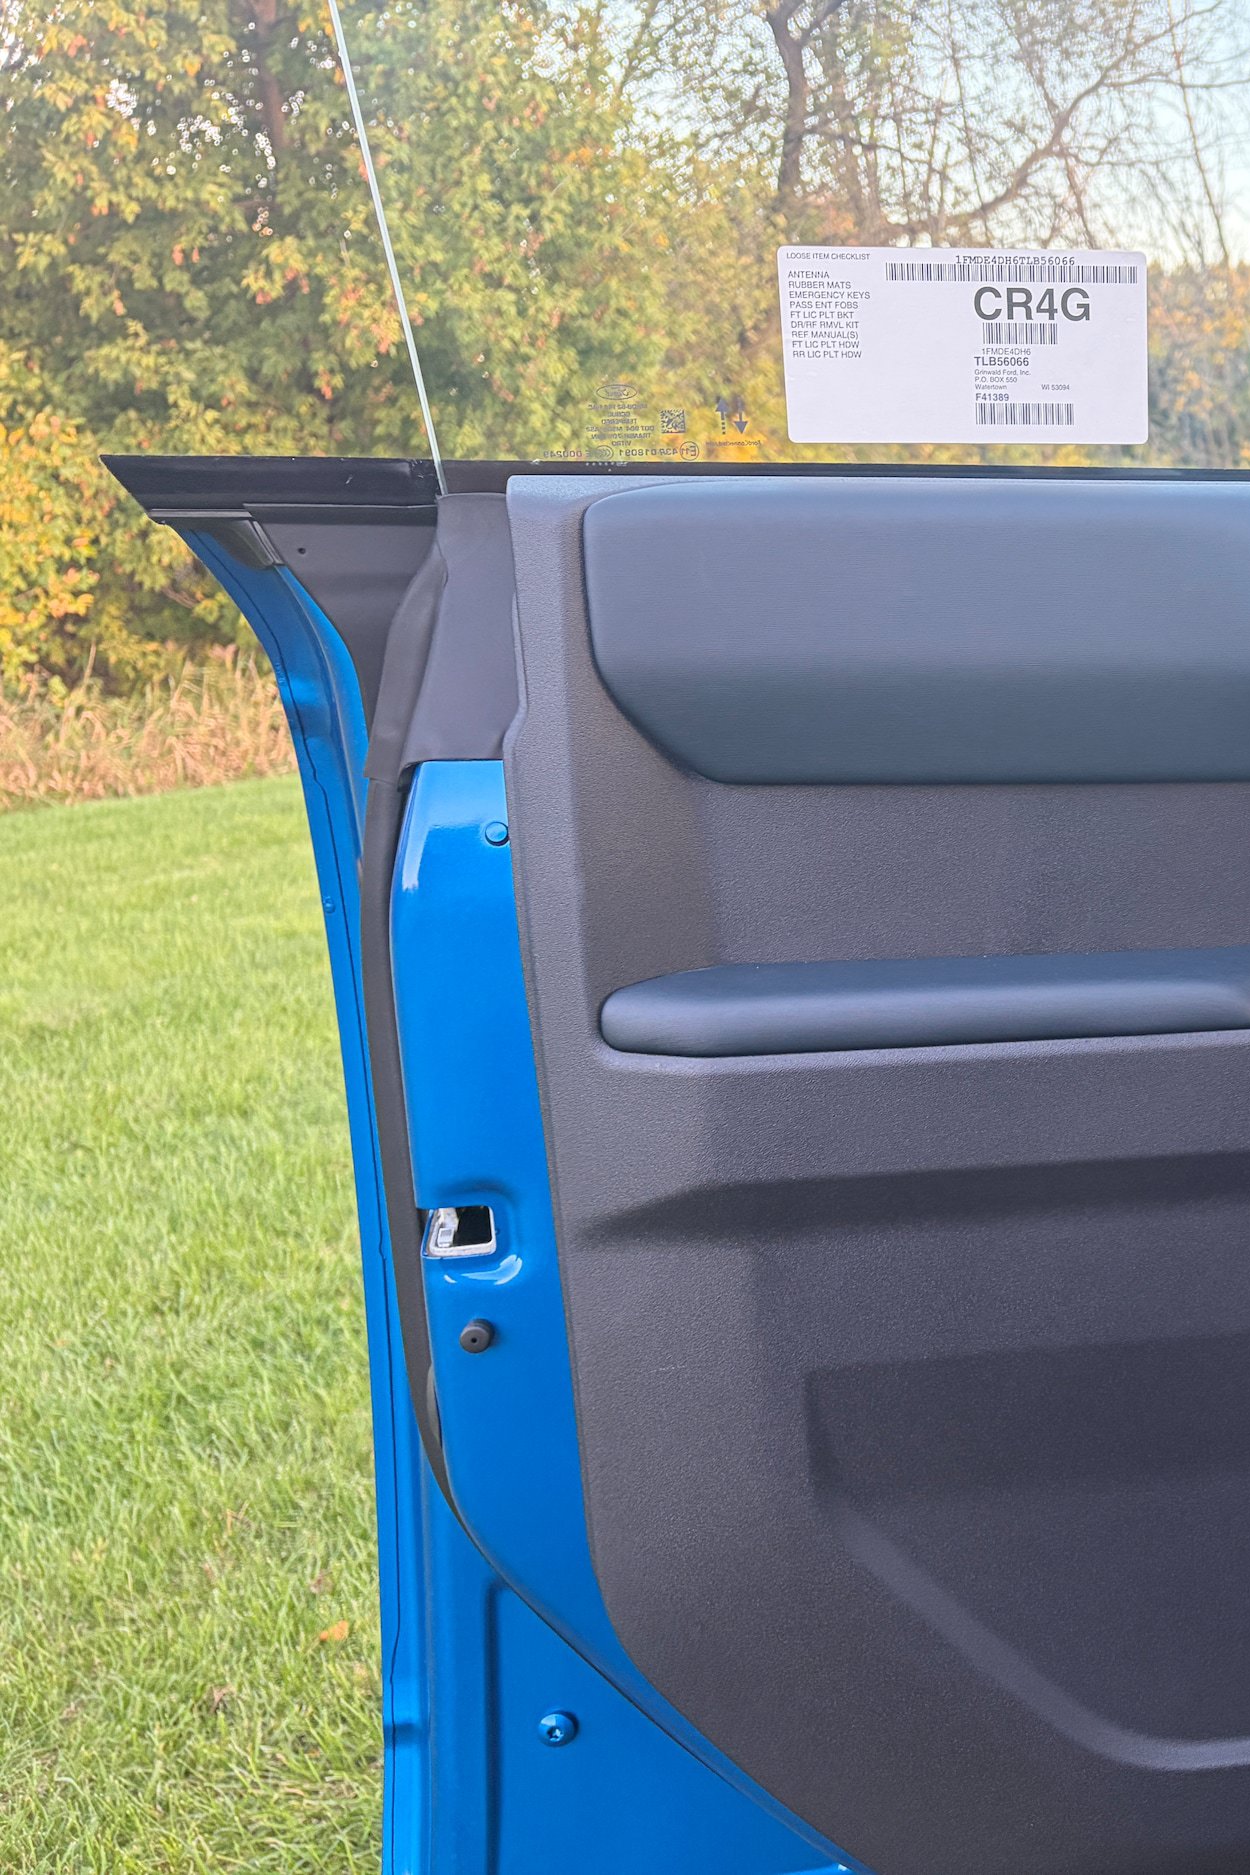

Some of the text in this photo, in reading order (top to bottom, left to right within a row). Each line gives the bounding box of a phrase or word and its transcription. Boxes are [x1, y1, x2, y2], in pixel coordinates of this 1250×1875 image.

[786, 252, 871, 261] LOOSE ITEM CHECKLIST
[955, 255, 1076, 265] 1FMDE4DH6TLB56066
[787, 270, 830, 279] ANTENNA
[788, 280, 852, 289] RUBBER MATS
[788, 290, 871, 300] EMERGENCY KEYS
[789, 300, 859, 310] PASS ENT FOBS
[973, 286, 1091, 322] CR4G
[790, 310, 855, 319] FT LIC PLT BKT
[790, 320, 860, 329] DR/RF RMVL KIT
[791, 330, 859, 340] REF MANUAL(S)
[792, 340, 860, 349] FT LIC PLT HDW
[792, 350, 862, 359] RR LIC PLT HDW
[981, 347, 1032, 356] 1FMDE4DH6
[973, 356, 1030, 367] TLB56066
[975, 392, 1010, 402] F41389
